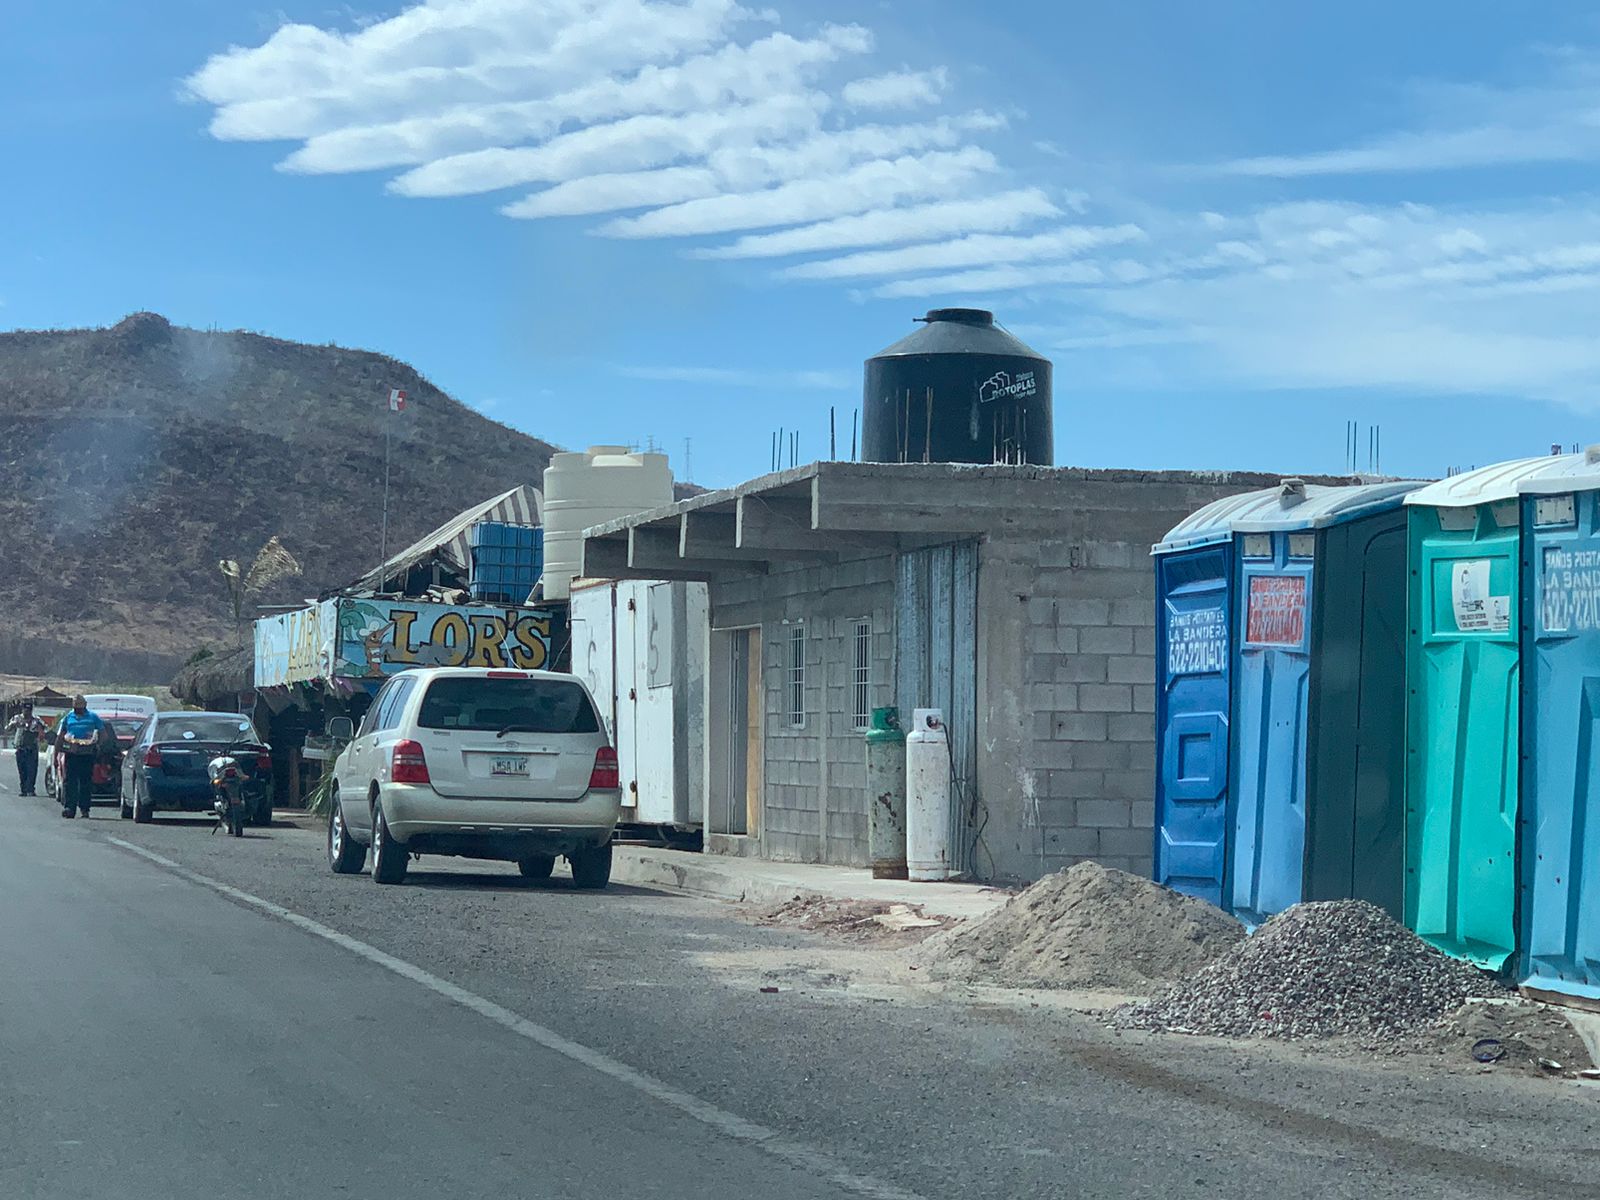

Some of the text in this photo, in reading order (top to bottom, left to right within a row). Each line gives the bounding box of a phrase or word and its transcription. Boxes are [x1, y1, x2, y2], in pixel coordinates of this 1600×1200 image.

[992, 378, 1036, 398] ROTOPLAS
[384, 609, 551, 669] LOR'S
[1169, 625, 1228, 642] LA BANDERA
